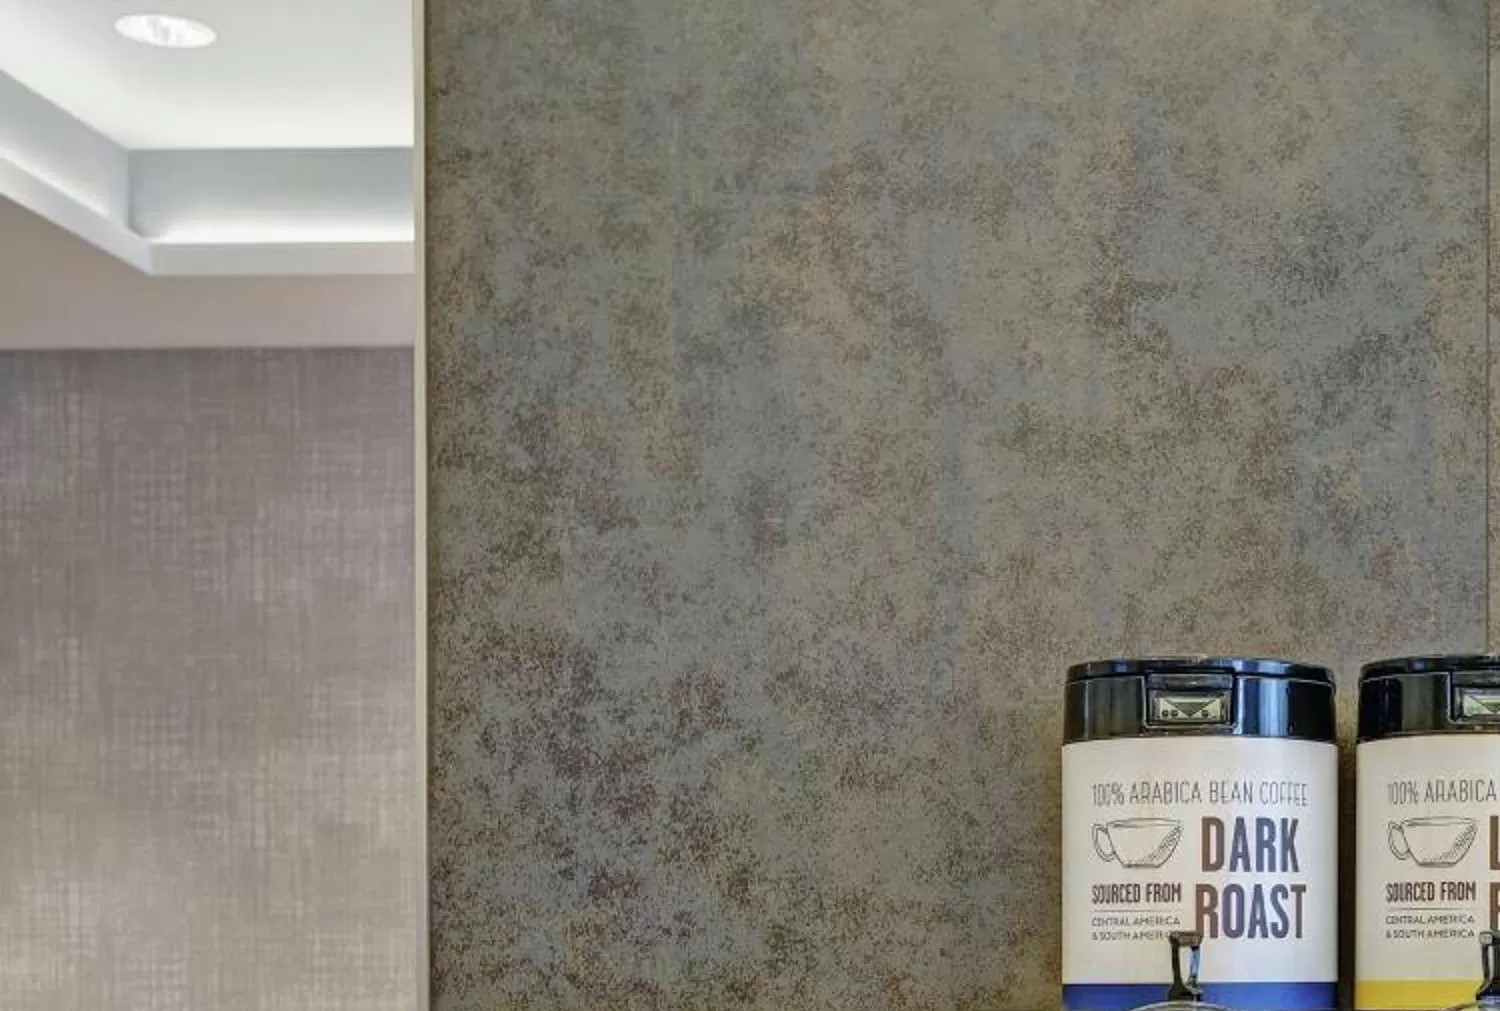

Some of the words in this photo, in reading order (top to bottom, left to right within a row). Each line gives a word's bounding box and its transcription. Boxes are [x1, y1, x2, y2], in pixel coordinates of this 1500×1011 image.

[1129, 781, 1202, 805] ARABICA
[1209, 780, 1253, 806] BEAN
[1259, 781, 1309, 807] COFFEE
[1387, 781, 1419, 805] 100%
[1424, 779, 1497, 803] ARABICA
[1201, 815, 1300, 873] DARK
[1091, 882, 1141, 904] SOURCED
[1146, 881, 1182, 903] FROM
[1385, 881, 1435, 902] SOURCED
[1440, 880, 1477, 901] FROM
[1091, 916, 1132, 927] CENTRAL
[1133, 915, 1181, 927] AMERICA
[1195, 882, 1307, 939] ROAST
[1385, 915, 1426, 926] CENTRAL
[1427, 914, 1475, 925] AMERICA
[1099, 931, 1131, 941] SOUTH
[1393, 930, 1425, 939] SOUTH
[1426, 929, 1475, 939] AMERICA
